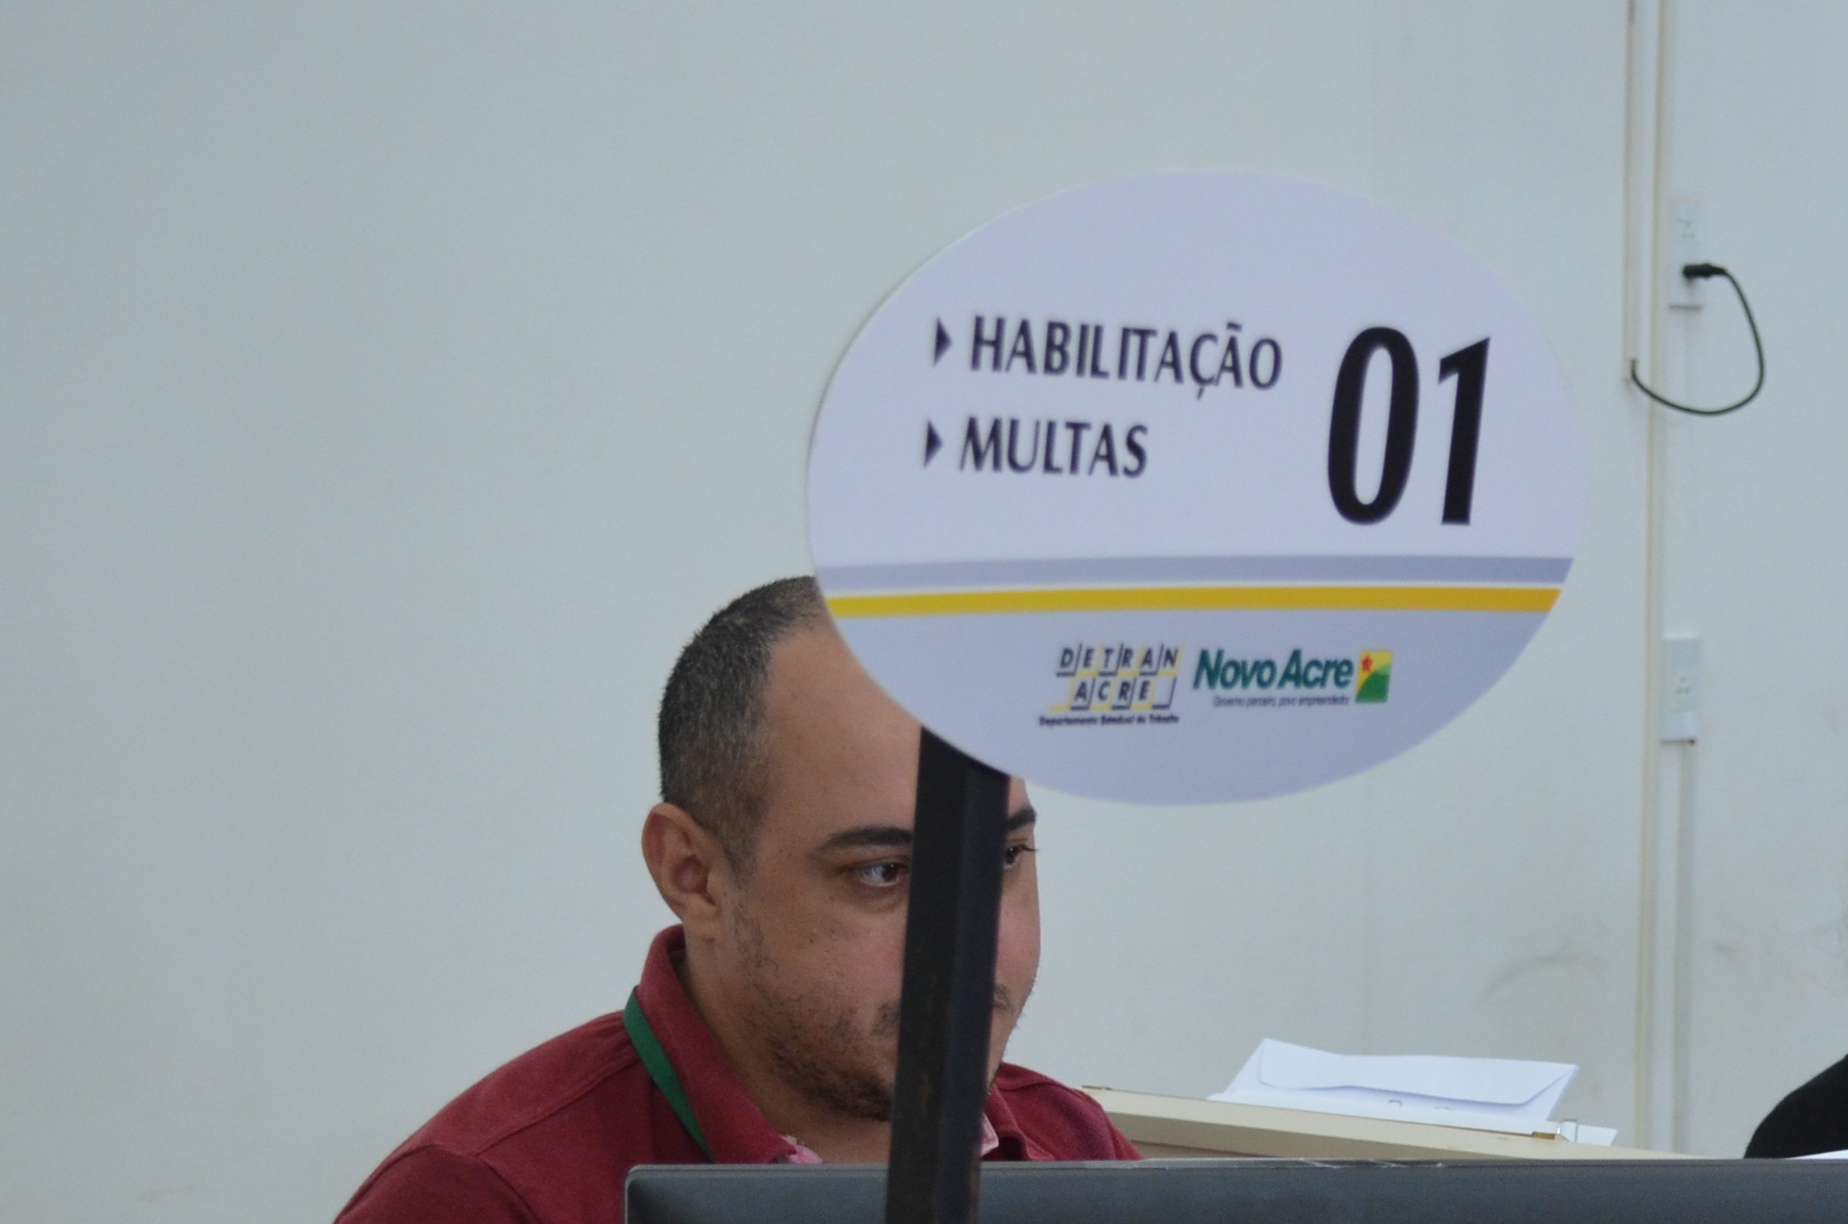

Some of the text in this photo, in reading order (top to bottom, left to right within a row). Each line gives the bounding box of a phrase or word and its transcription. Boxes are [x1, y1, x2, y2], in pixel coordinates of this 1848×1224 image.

[970, 314, 1283, 399] HABILITAÇÃO
[960, 415, 1149, 478] MULTAS
[1326, 325, 1492, 527] 01
[1058, 646, 1180, 670] DETRAN
[1193, 648, 1354, 690] Novo Acre
[1073, 680, 1152, 702] ACRE
